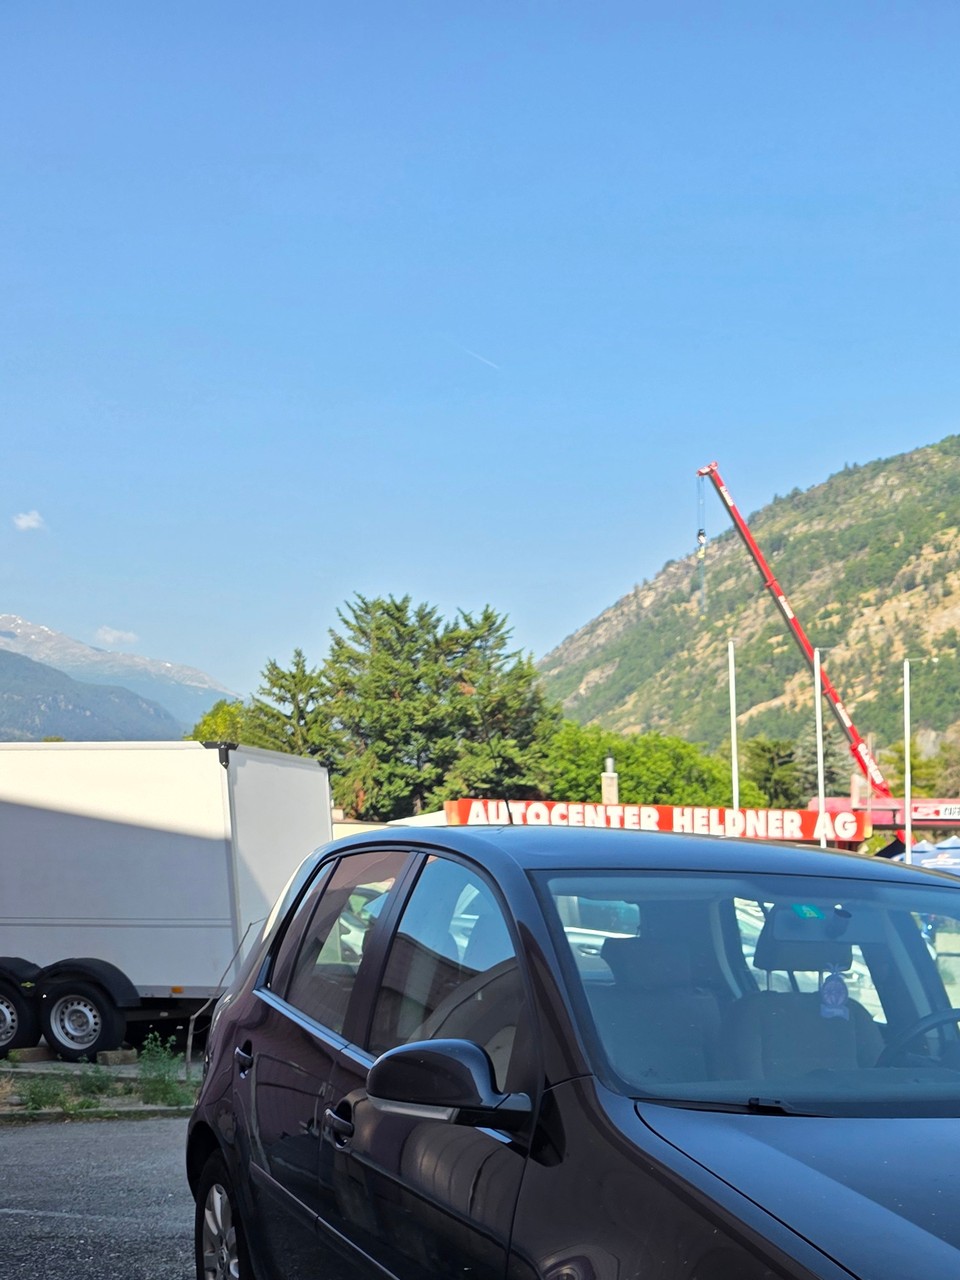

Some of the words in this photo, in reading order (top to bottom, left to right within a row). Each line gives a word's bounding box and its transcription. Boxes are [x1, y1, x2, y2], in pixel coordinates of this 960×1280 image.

[467, 800, 659, 830] AUTOCENTER
[672, 807, 803, 838] HELDNER
[813, 811, 857, 839] AG
